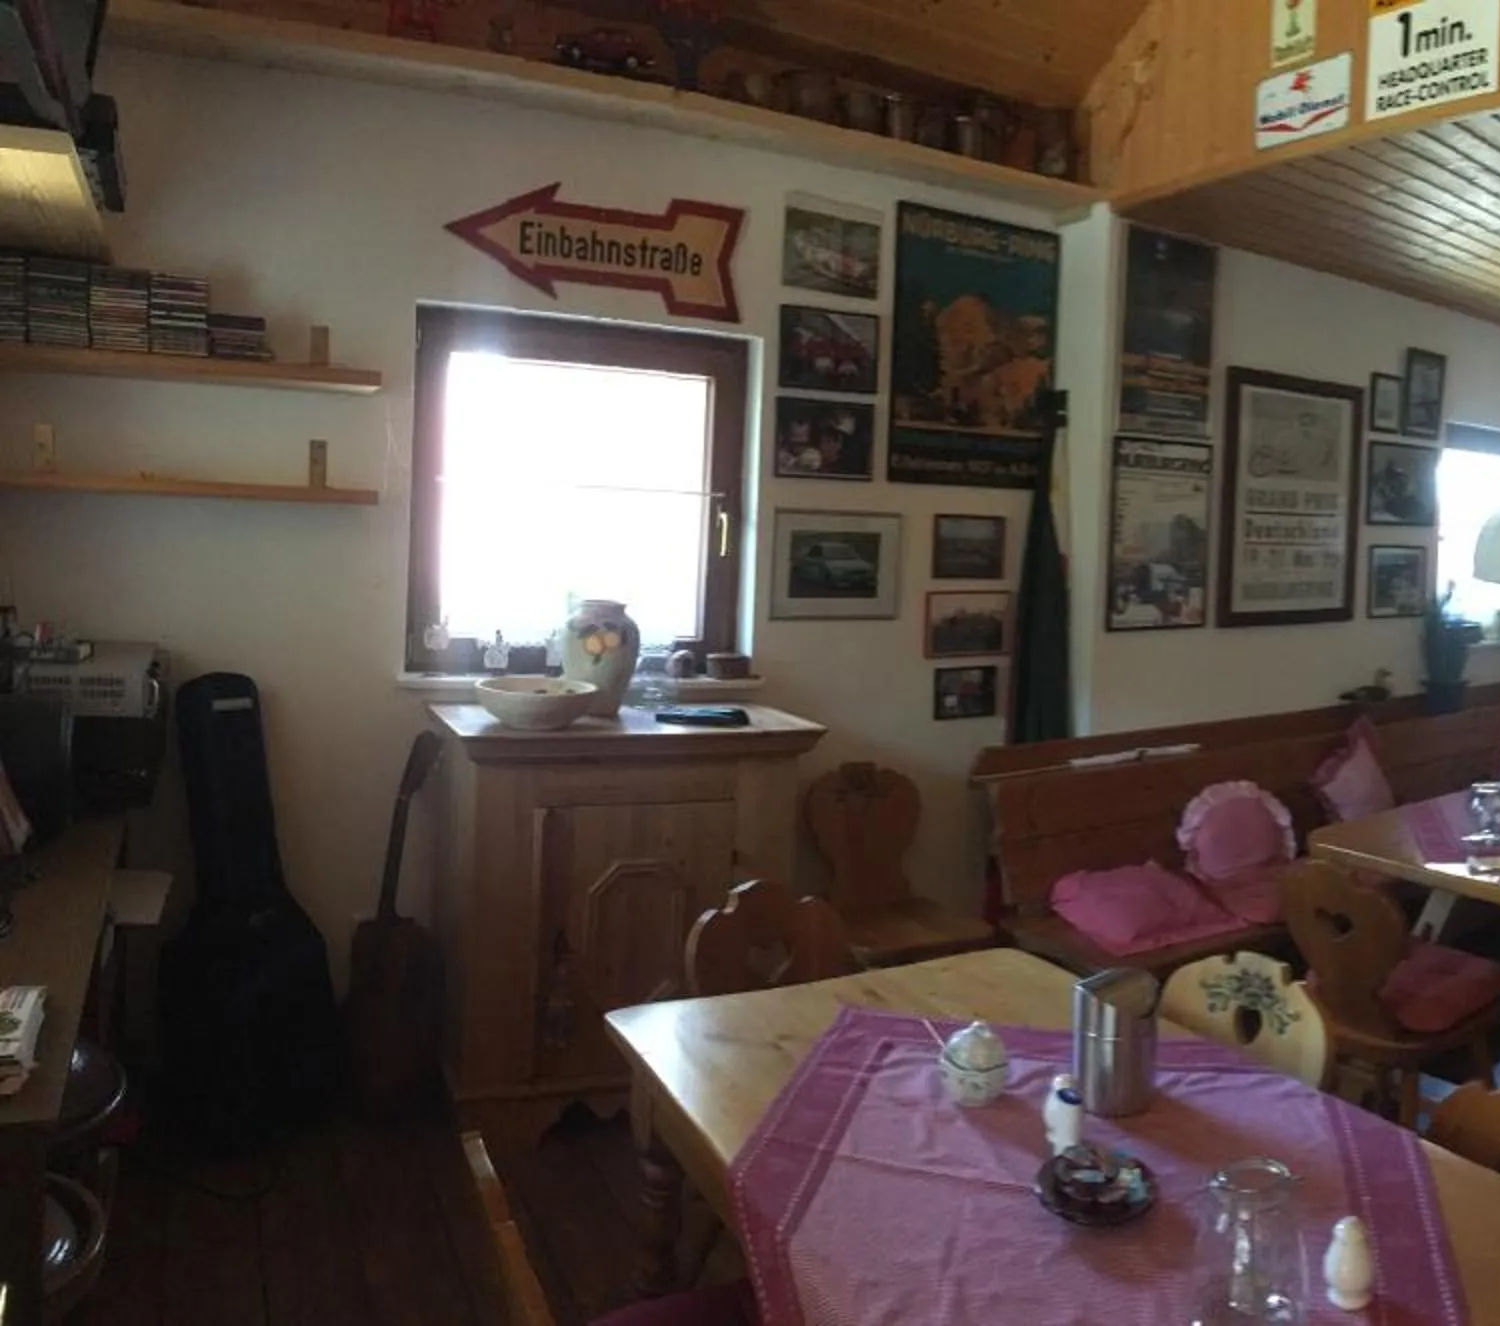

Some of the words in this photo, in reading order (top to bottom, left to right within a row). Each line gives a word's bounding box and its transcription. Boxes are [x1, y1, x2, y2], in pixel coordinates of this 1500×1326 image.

[1397, 11, 1412, 58] 1
[1416, 16, 1473, 53] min.
[1377, 47, 1489, 90] HEADQUARTER
[1375, 71, 1491, 112] RACE-CONTROL
[518, 220, 704, 276] Einbahnstraße
